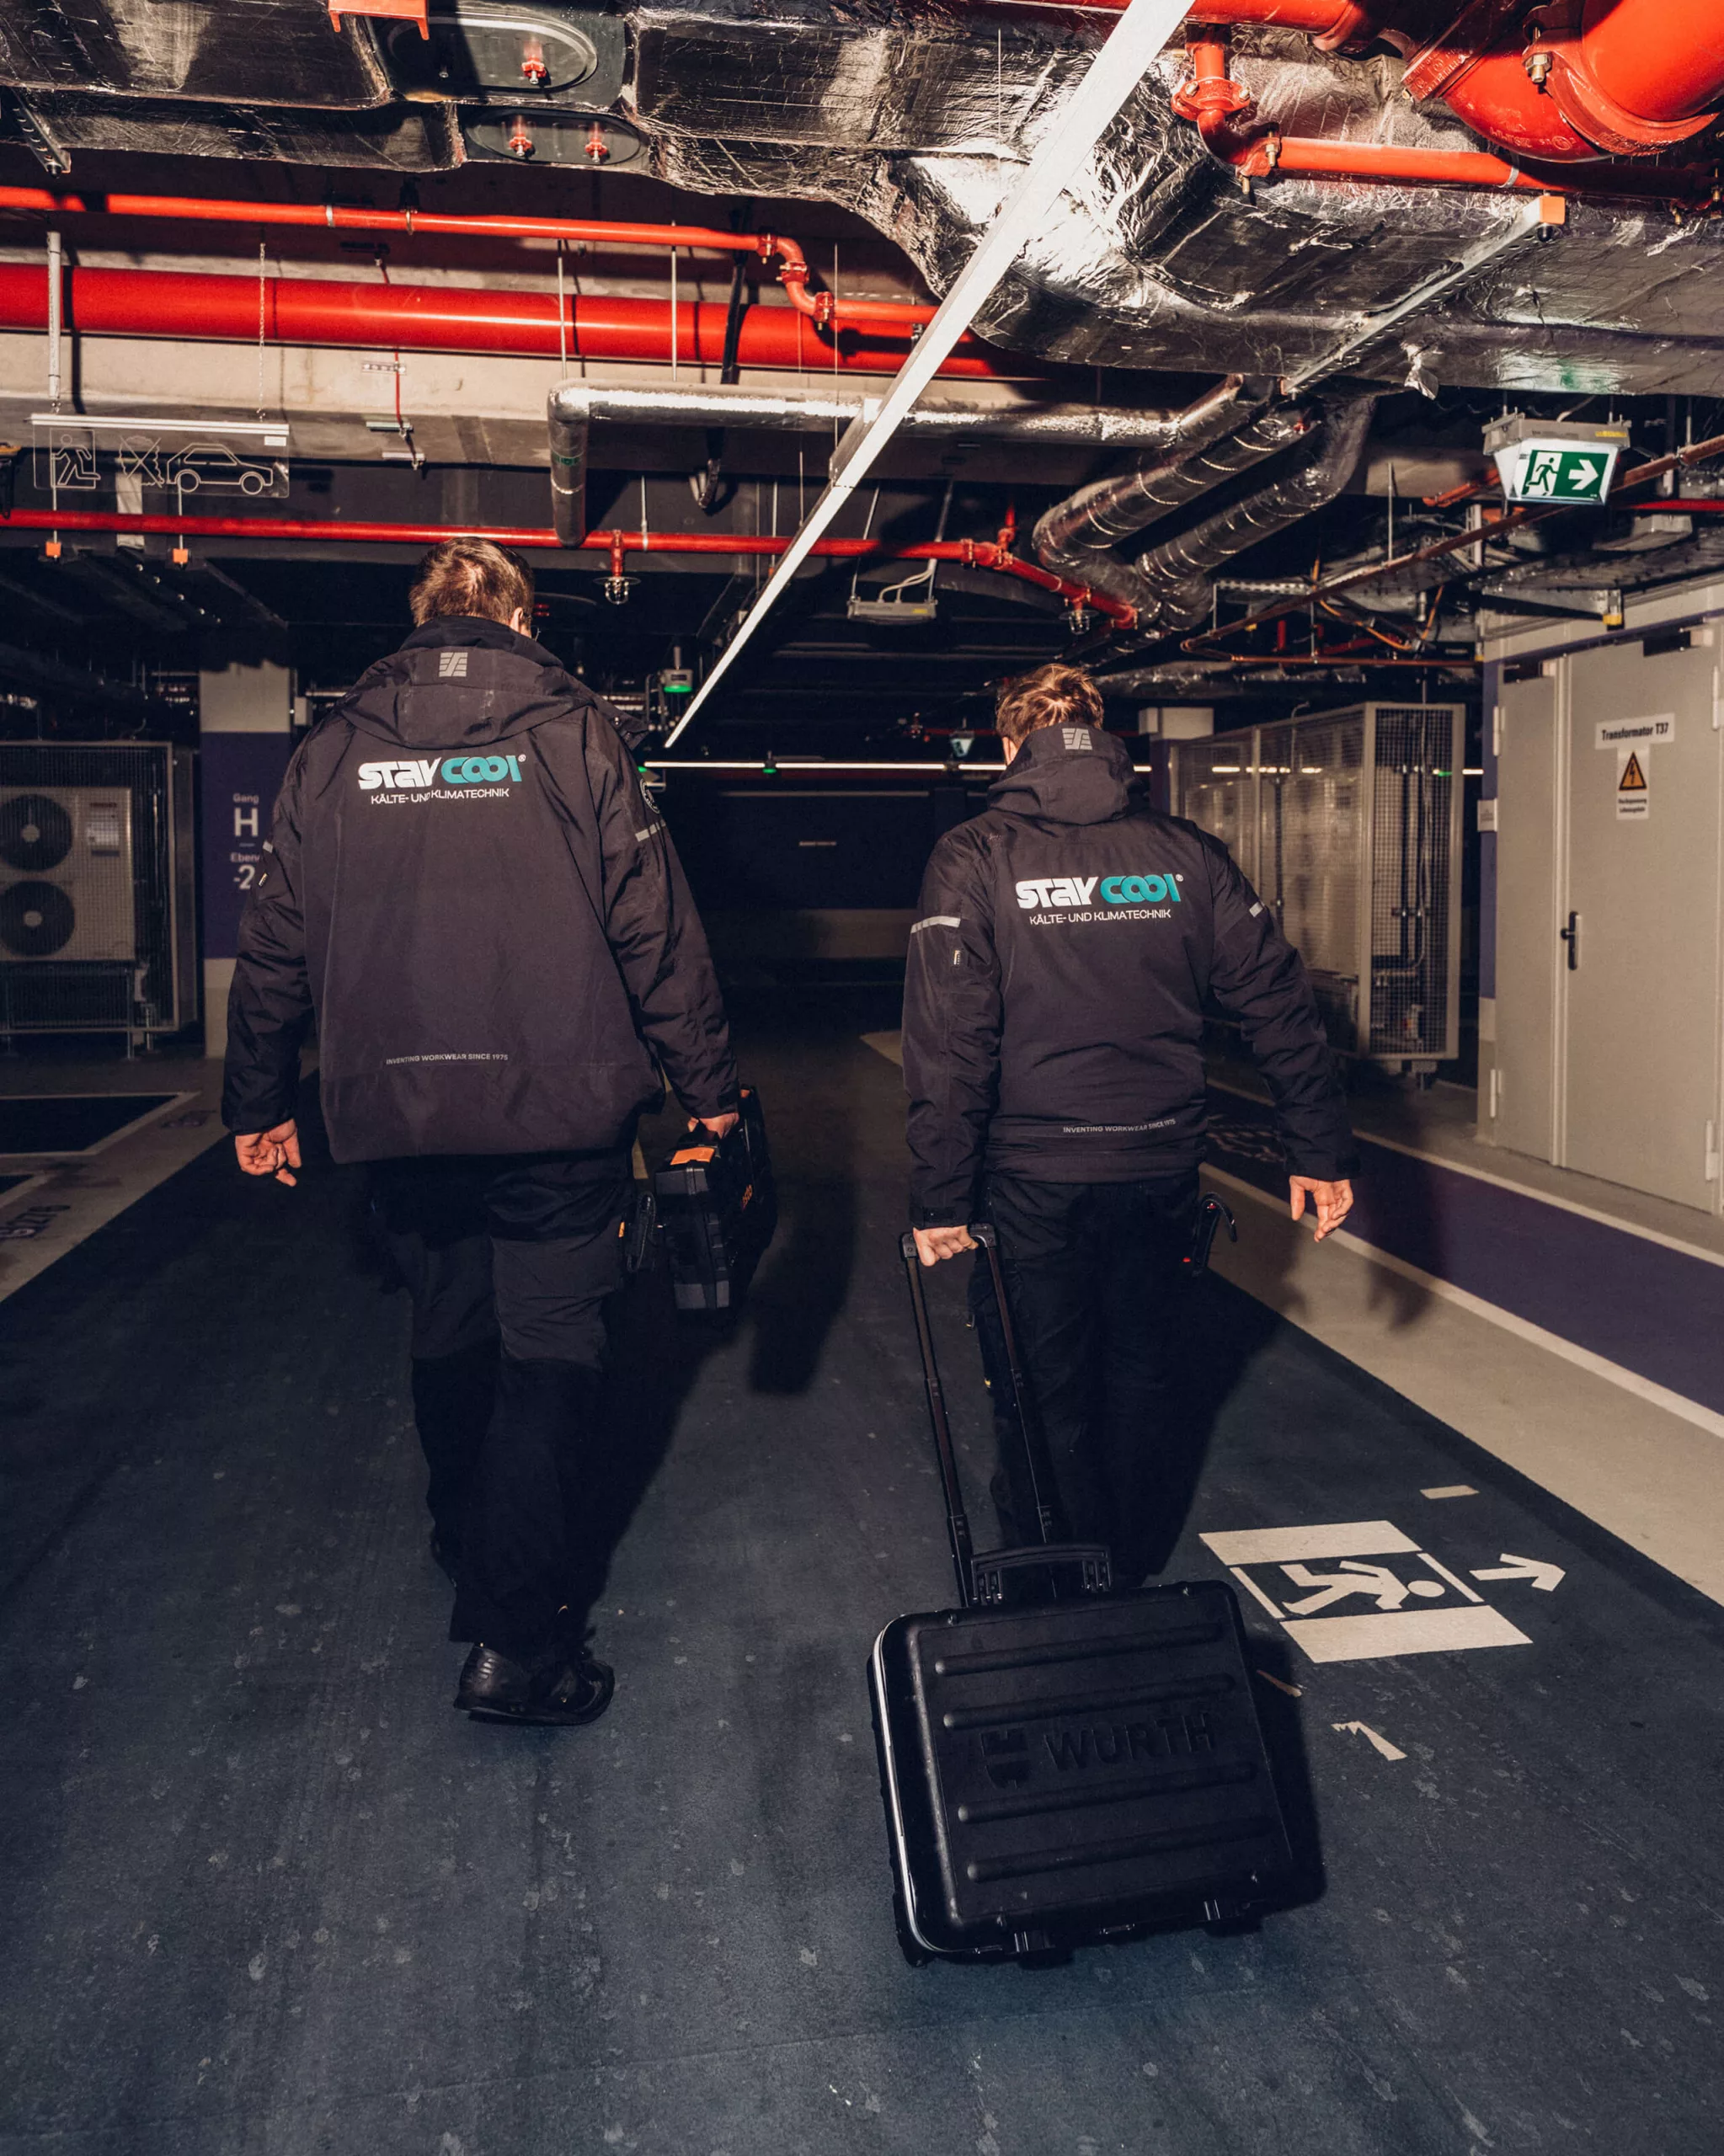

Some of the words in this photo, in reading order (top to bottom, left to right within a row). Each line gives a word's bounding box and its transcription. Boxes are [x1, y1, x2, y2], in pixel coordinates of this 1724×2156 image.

[1602, 727, 1653, 741] Transformator
[1655, 722, 1669, 735] T37
[232, 793, 259, 805] Gang
[371, 793, 409, 804] KÄLTE-
[411, 792, 430, 803] UND
[430, 788, 510, 800] KLIMATECHNIK
[234, 808, 259, 836] H
[1029, 914, 1067, 925] KÄLTE-
[1068, 912, 1092, 922] UND
[1094, 909, 1172, 921] KLIMATECHNIK
[386, 1055, 420, 1065] INVENTING
[1104, 1123, 1148, 1132] WORKWEAR
